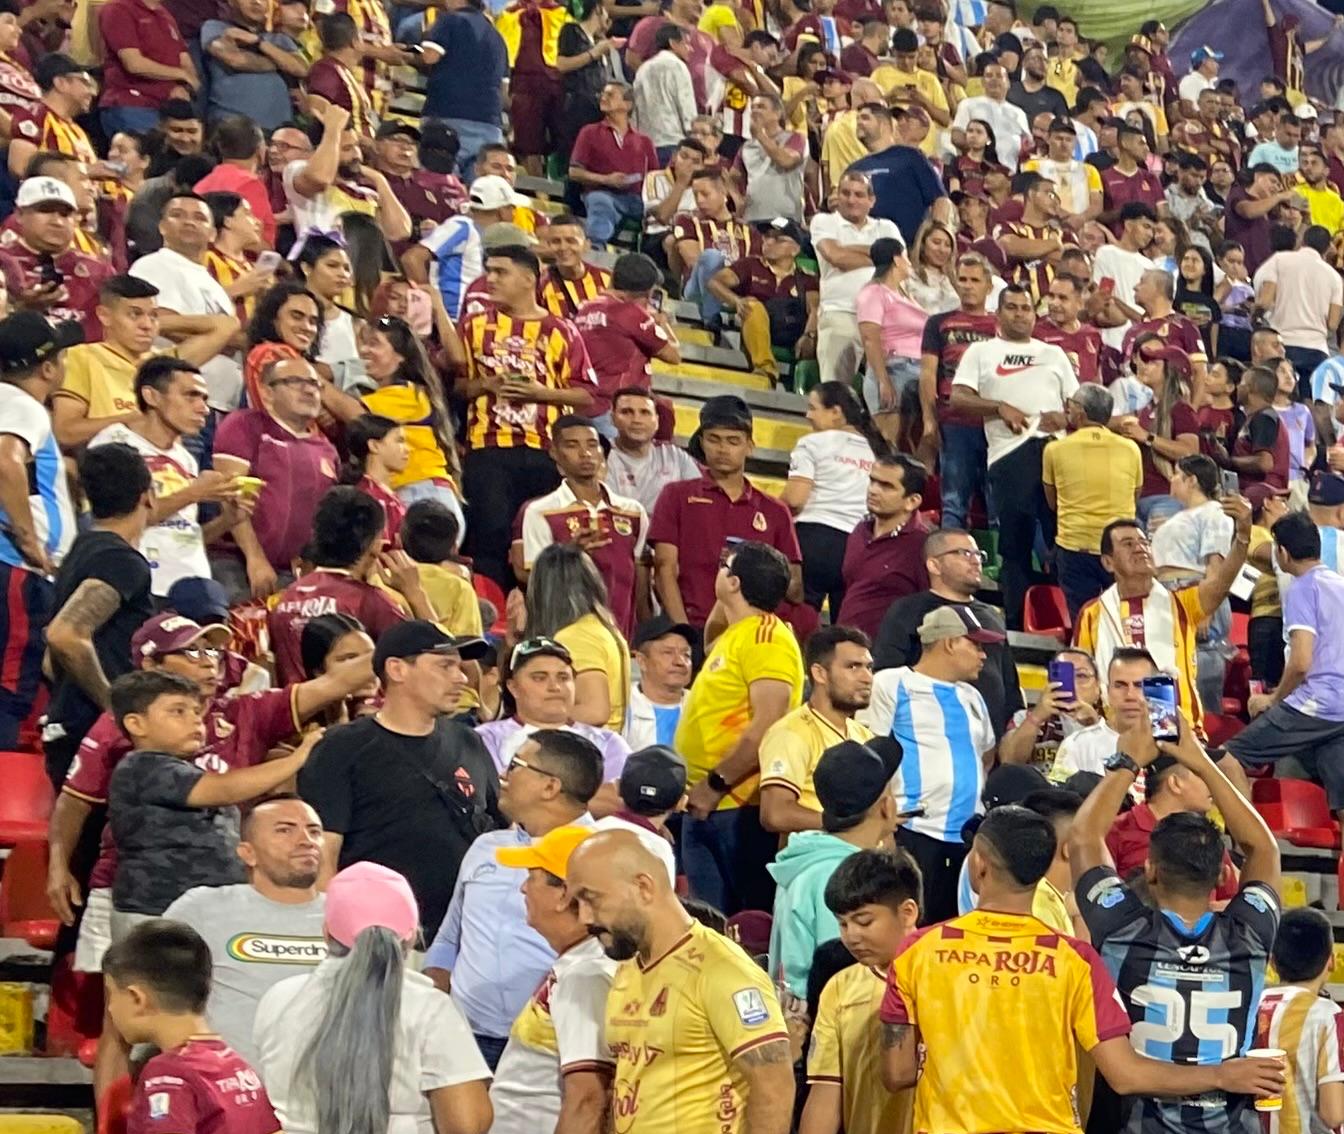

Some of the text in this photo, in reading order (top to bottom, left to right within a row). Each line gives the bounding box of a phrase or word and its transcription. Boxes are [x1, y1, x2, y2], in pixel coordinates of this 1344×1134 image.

[1003, 355, 1036, 366] NIKE
[935, 949, 1058, 978] TAPA ROJA
[968, 973, 1021, 987] ORO
[1130, 985, 1242, 1061] 25
